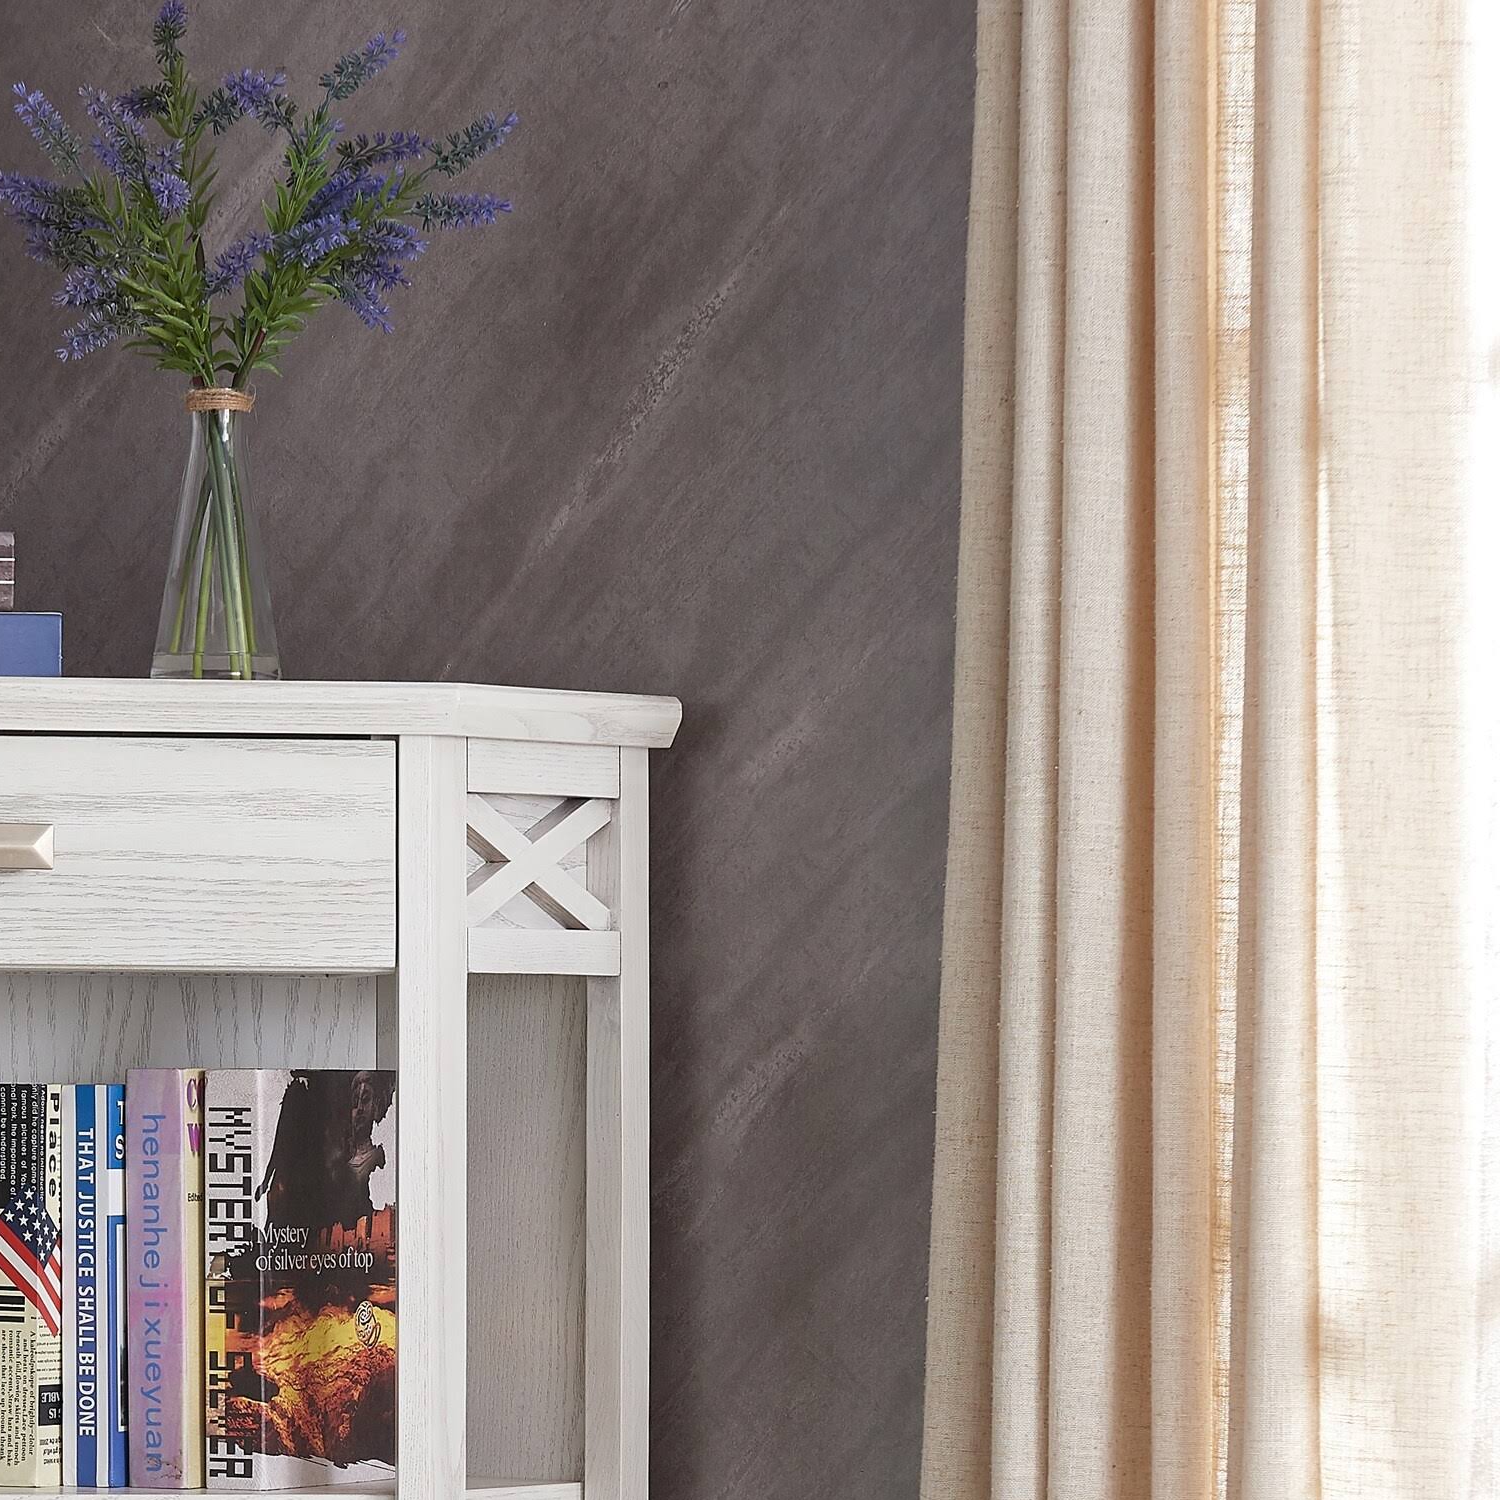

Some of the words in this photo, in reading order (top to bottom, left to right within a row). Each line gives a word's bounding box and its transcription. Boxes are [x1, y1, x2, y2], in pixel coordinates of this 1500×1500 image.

[49, 1092, 60, 1198] Place
[78, 1128, 94, 1184] THAT
[78, 1192, 94, 1277] JUSTICE
[257, 1222, 309, 1248] Mystery
[274, 1248, 308, 1270] silver
[310, 1251, 337, 1274] eyes
[338, 1246, 354, 1269] of
[354, 1249, 374, 1274] top
[78, 1286, 94, 1347] SHALL
[78, 1352, 94, 1376] BE
[78, 1382, 95, 1436] DONE
